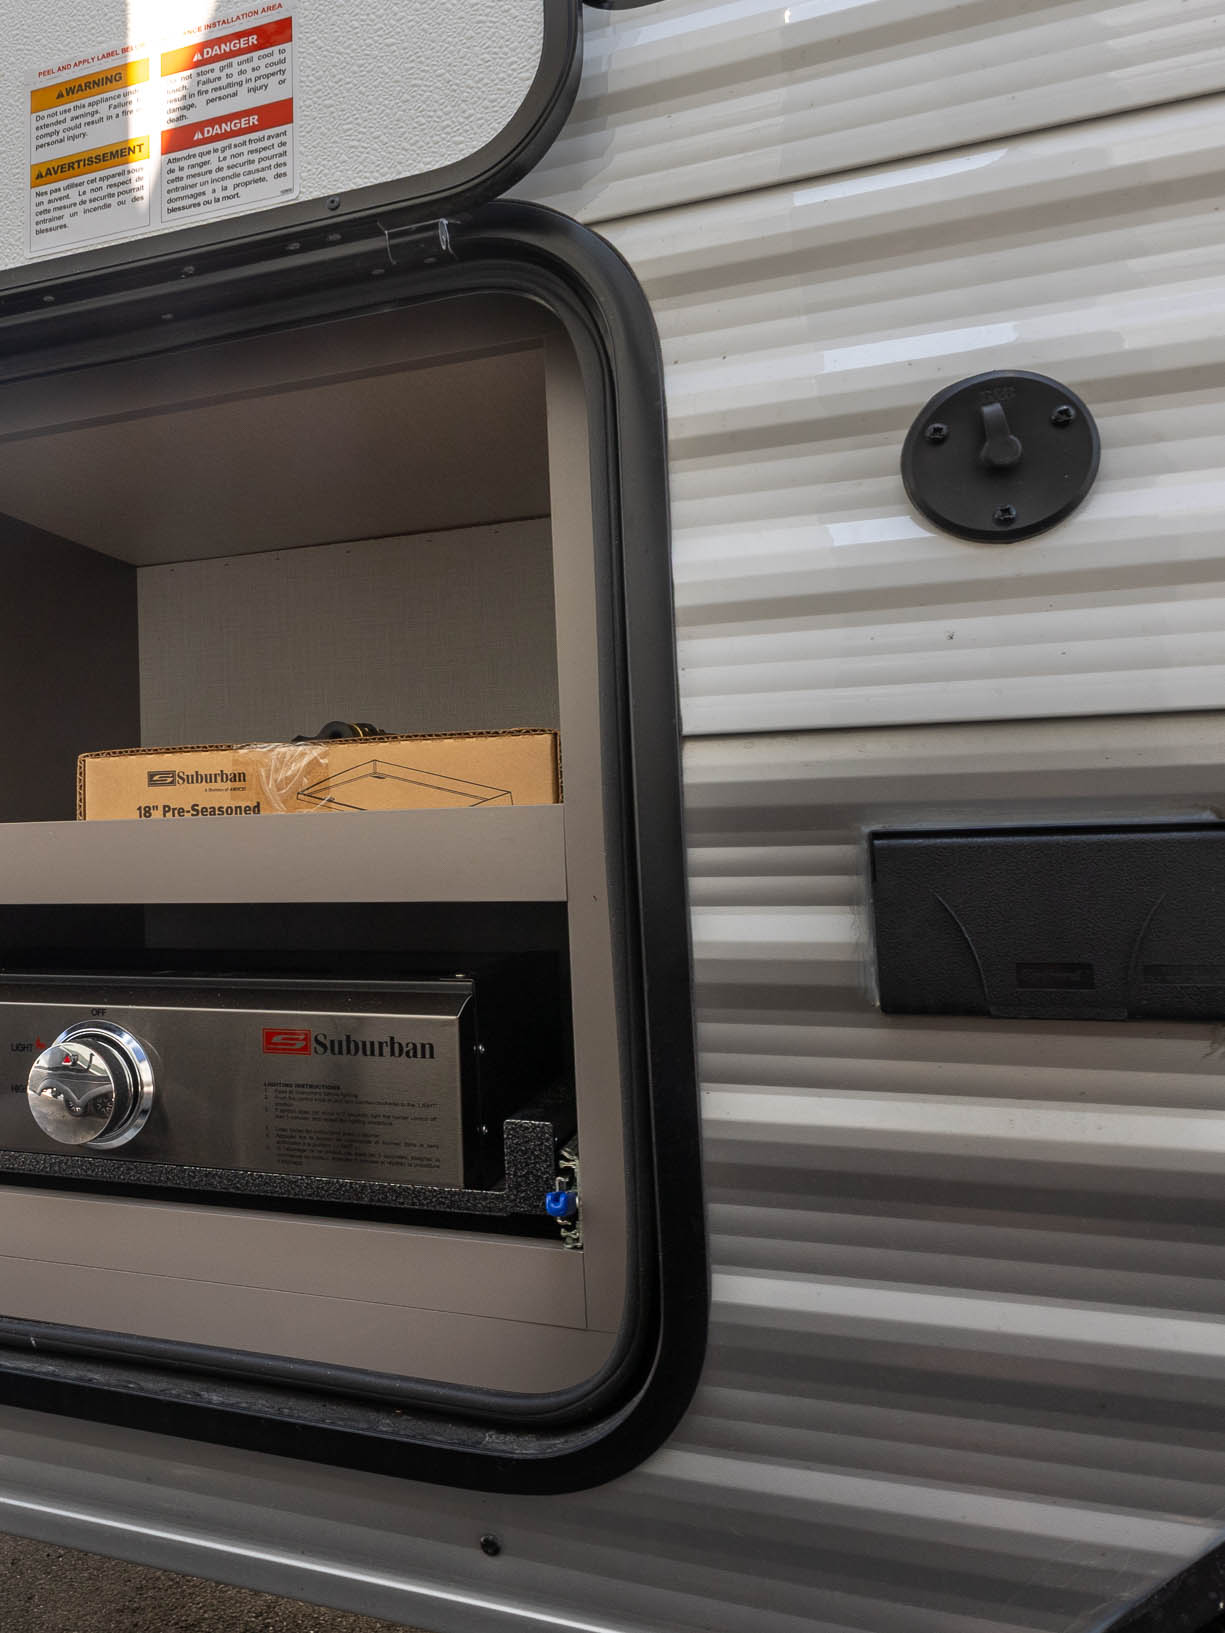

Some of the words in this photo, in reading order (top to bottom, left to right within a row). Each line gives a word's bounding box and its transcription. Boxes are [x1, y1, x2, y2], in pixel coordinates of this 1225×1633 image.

[204, 8, 259, 31] INSTALLATION
[259, 3, 283, 17] AREA
[203, 34, 257, 58] DANGER
[37, 67, 56, 78] PEEL
[56, 62, 72, 74] AND
[73, 56, 96, 70] APPLY
[96, 50, 120, 63] LABEL
[196, 67, 214, 77] store
[219, 61, 232, 72] grill
[237, 56, 253, 65] until
[258, 50, 273, 60] cool
[197, 74, 221, 86] Failure
[225, 71, 233, 79] to
[237, 67, 247, 75] do
[264, 57, 285, 68] could
[64, 71, 122, 96] WARNING
[197, 88, 208, 96] fire
[210, 79, 243, 94] resulting
[245, 76, 252, 84] in
[254, 67, 286, 83] property
[206, 90, 237, 105] personal
[247, 82, 268, 94] injury
[35, 113, 44, 122] Do
[46, 110, 57, 118] not
[59, 107, 71, 115] use
[73, 102, 85, 111] this
[87, 92, 121, 108] appliance
[35, 117, 66, 131] extended
[70, 108, 100, 123] awnings.
[108, 99, 132, 111] Failure
[35, 128, 59, 141] comply
[62, 122, 81, 133] could
[83, 116, 103, 127] result
[203, 114, 258, 137] DANGER
[35, 136, 65, 150] personal
[67, 130, 87, 142] injury.
[166, 152, 196, 165] Attendre
[198, 150, 211, 158] que
[213, 146, 220, 154] le
[220, 143, 232, 153] gril
[233, 139, 246, 148] soit
[248, 135, 265, 145] froid
[266, 129, 286, 140] avant
[44, 143, 144, 177] AVERTISSEMENT
[167, 167, 175, 175] de
[187, 160, 211, 171] ranger.
[230, 151, 244, 159] non
[247, 143, 274, 157] respect
[278, 140, 286, 148] de
[167, 175, 183, 184] cette
[186, 169, 212, 180] mesure
[215, 165, 224, 173] de
[258, 150, 286, 164] pourrait
[50, 187, 60, 195] pas
[63, 180, 84, 191] utiliser
[87, 177, 96, 185] cet
[98, 169, 125, 183] appareil
[106, 178, 131, 190] respect
[210, 171, 240, 184] incendie
[242, 164, 271, 176] causant
[273, 160, 286, 169] des
[35, 207, 51, 216] cette
[52, 202, 77, 212] mesure
[79, 198, 87, 206] de
[117, 184, 144, 198] pourrait
[167, 190, 205, 205] dommages
[274, 170, 287, 179] des
[83, 202, 111, 214] incendie
[131, 194, 143, 202] des
[167, 201, 200, 214] blessures
[176, 769, 247, 785] Suburban
[136, 804, 159, 819] 18"
[162, 801, 261, 818] Pre-Seasoned
[90, 1008, 107, 1017] OFF
[11, 1043, 33, 1052] LIGHT
[313, 1032, 435, 1060] Suburban
